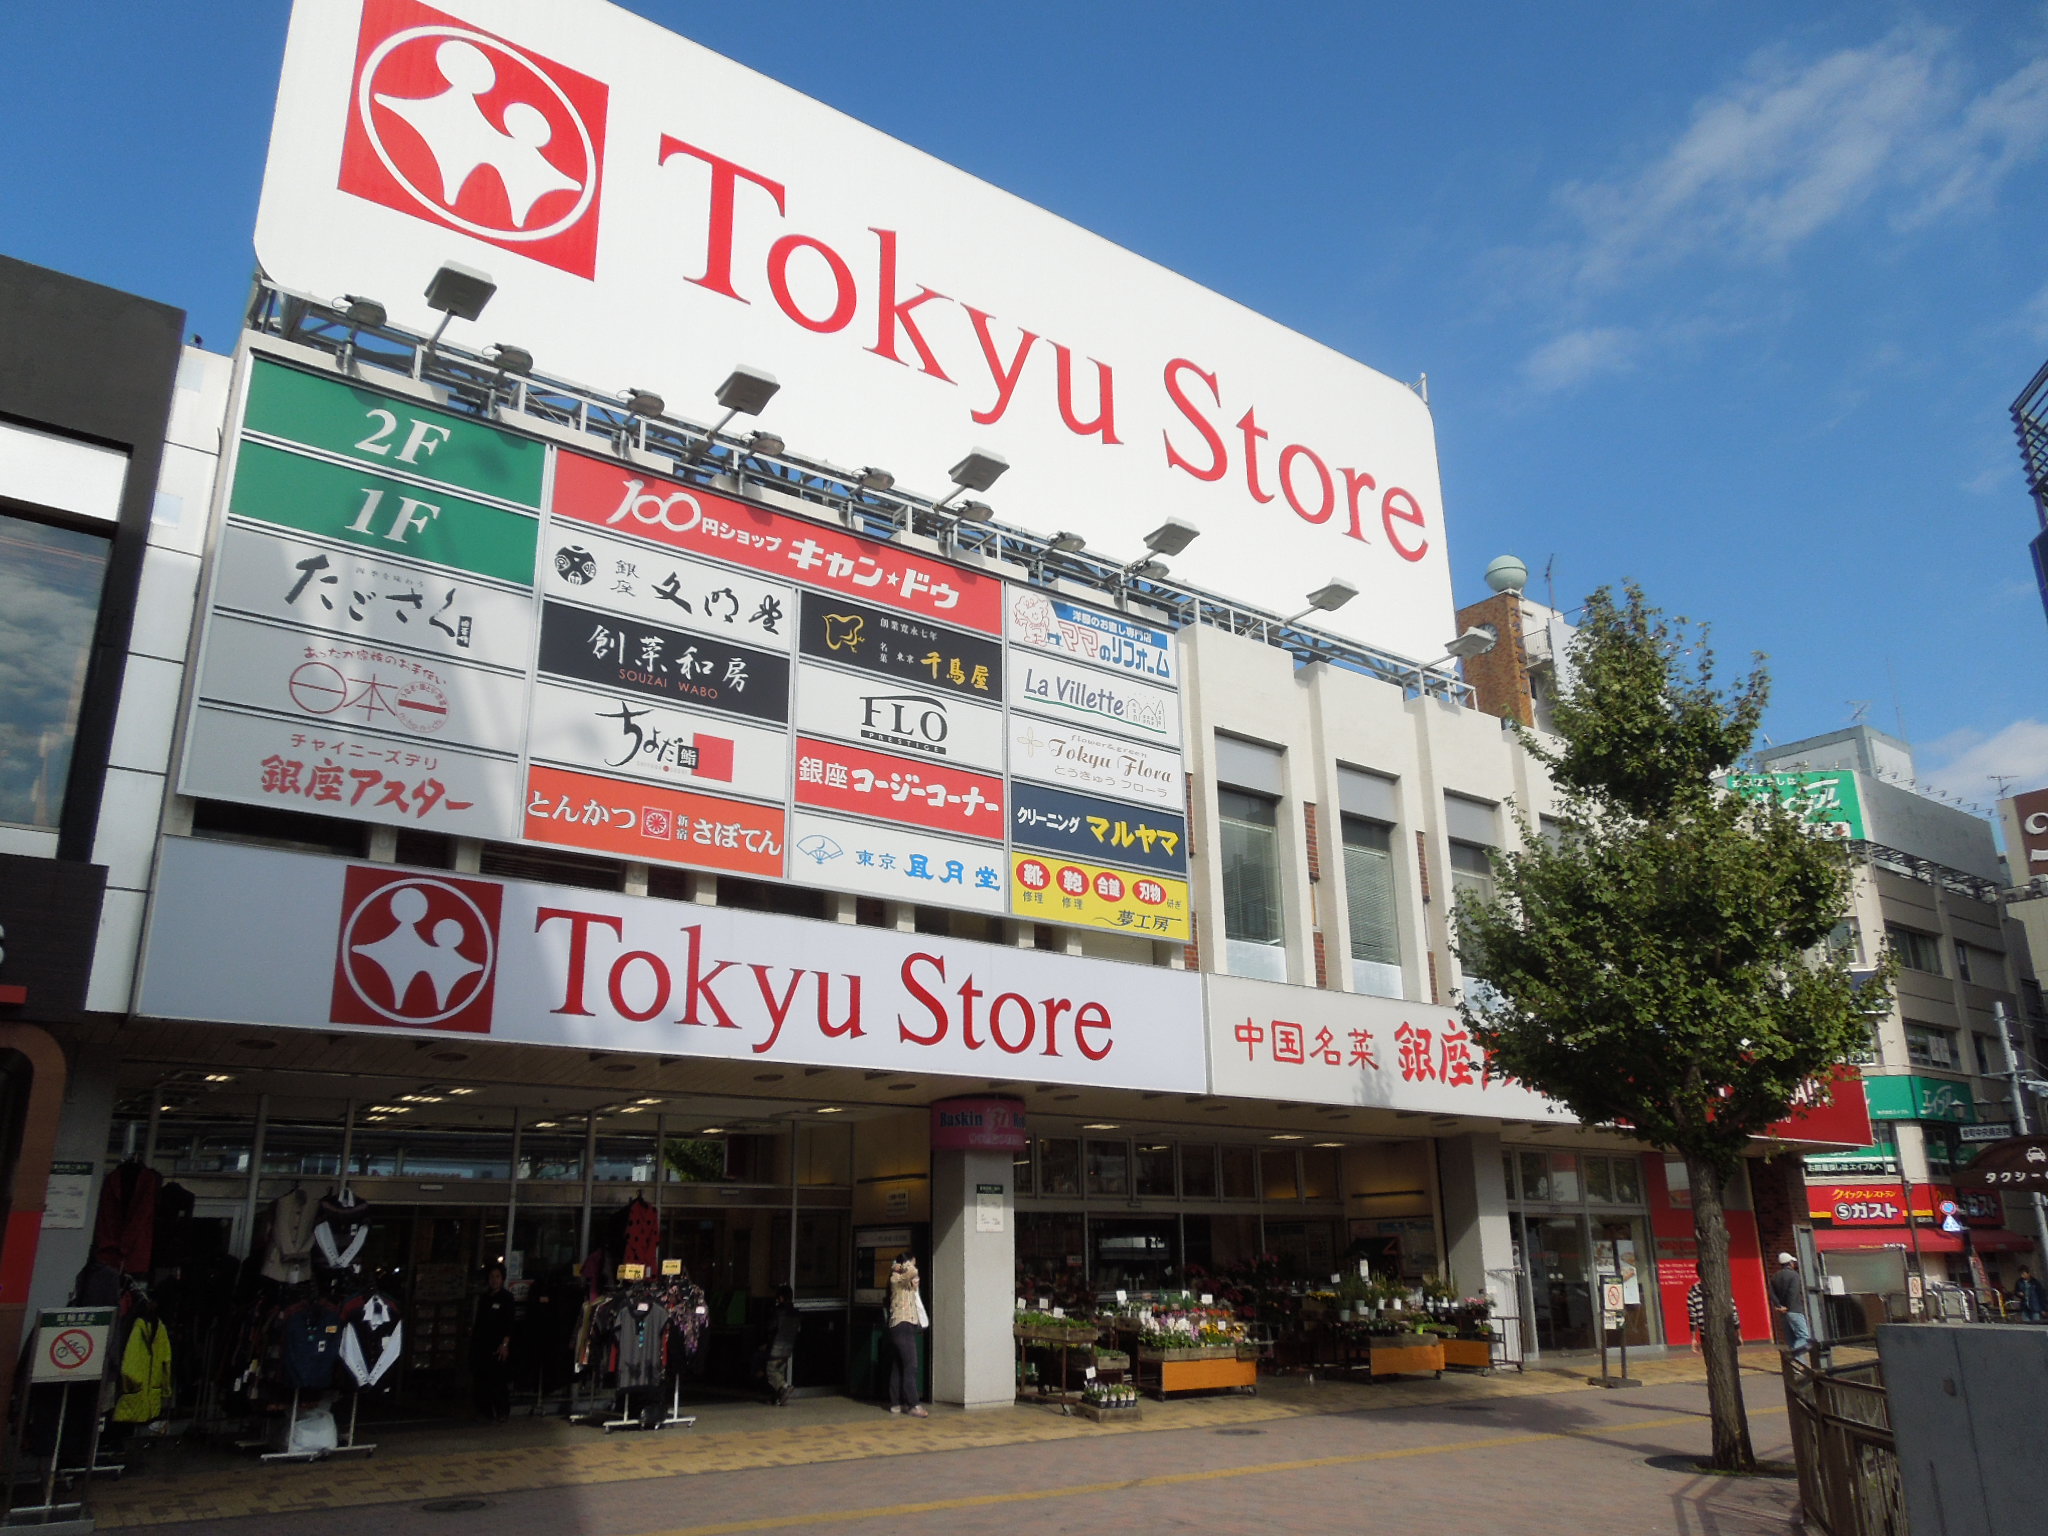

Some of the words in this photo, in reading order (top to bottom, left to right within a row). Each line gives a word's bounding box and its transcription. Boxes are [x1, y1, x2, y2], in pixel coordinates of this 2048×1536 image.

[658, 132, 1124, 445] Tokyu
[1163, 357, 1429, 563] Store
[354, 408, 451, 465] 2F
[344, 488, 441, 544] 1F
[284, 553, 456, 638] たごさく
[610, 558, 640, 597] 銀座
[586, 624, 750, 693] 創菜和房
[920, 651, 989, 691] 千鳥屋
[618, 668, 667, 689] SOUZAI
[678, 681, 719, 700] WABO
[1025, 668, 1049, 697] La
[1056, 675, 1125, 717] Villette
[859, 695, 948, 742] FLO
[291, 733, 438, 771] チャイニーズデリ
[869, 732, 939, 753] PRESTIGE
[1048, 738, 1111, 769] Tokyu
[1116, 755, 1172, 783] Flora
[261, 753, 474, 819] 銀座アスター
[1121, 779, 1168, 798] フローラ
[527, 790, 637, 830] とんかつ
[676, 814, 689, 841] 新宿
[692, 817, 782, 857] さぼてん
[1017, 806, 1081, 834] クリーニング
[1086, 815, 1180, 857] マルヤマ
[1022, 890, 1044, 904] 修理
[1062, 896, 1084, 911] 修理
[1118, 909, 1177, 932] 夢工房
[534, 906, 867, 1054] Tokyu
[897, 951, 1114, 1062] Store
[1234, 1017, 1380, 1071] 中国名菜
[940, 1111, 983, 1128] Baskin
